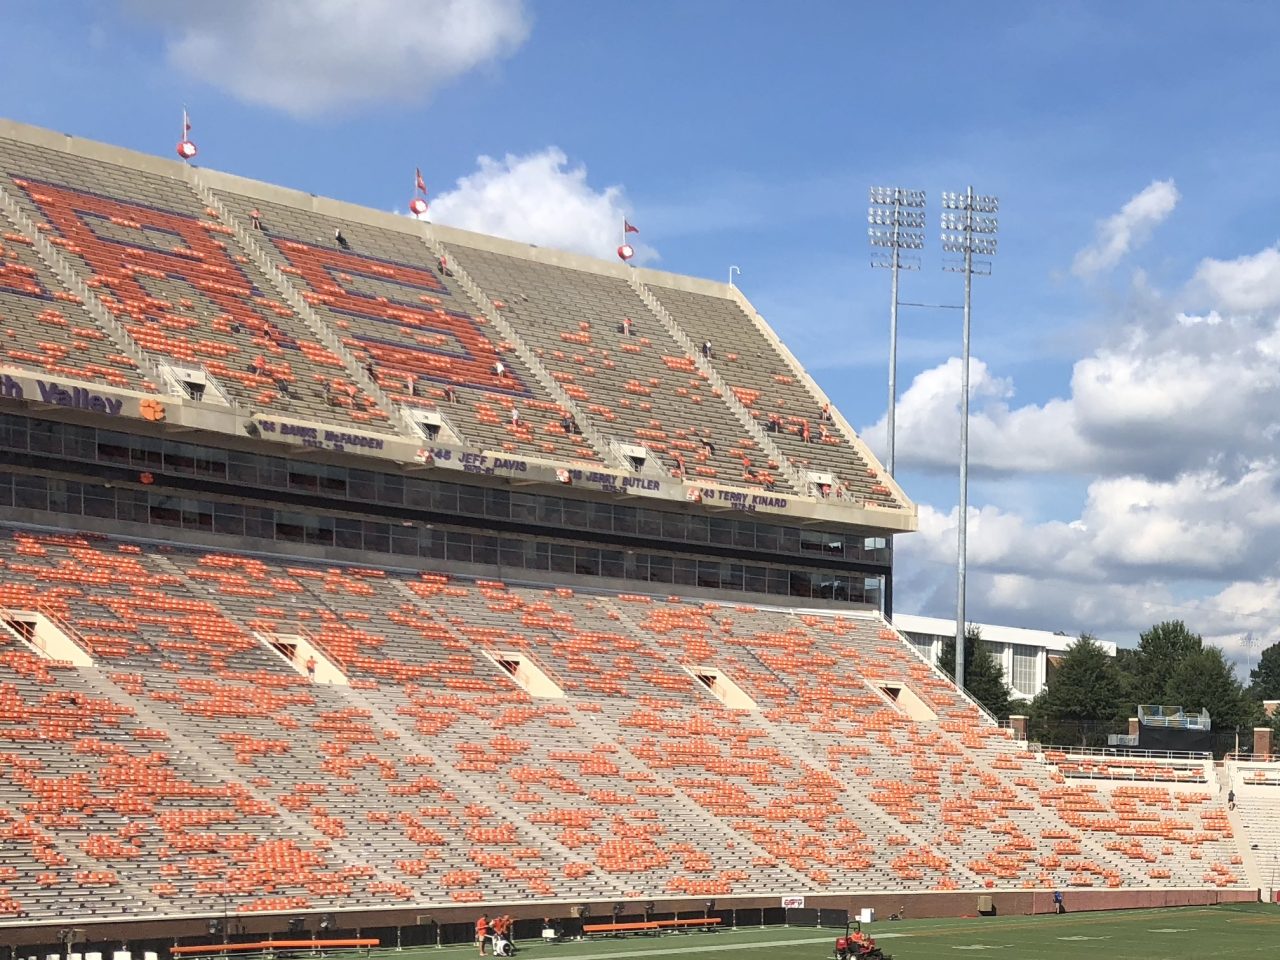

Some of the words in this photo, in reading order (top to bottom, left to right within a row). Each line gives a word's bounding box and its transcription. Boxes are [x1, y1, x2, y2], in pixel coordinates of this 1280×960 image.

[36, 379, 122, 416] Valley
[325, 430, 383, 450] McFADDEN
[458, 452, 488, 465] JEFF
[494, 457, 527, 472] DAVIS
[586, 472, 617, 485] JERRY
[622, 476, 660, 491] BUTLER
[718, 490, 748, 503] TERRY
[752, 495, 787, 508] KINARD
